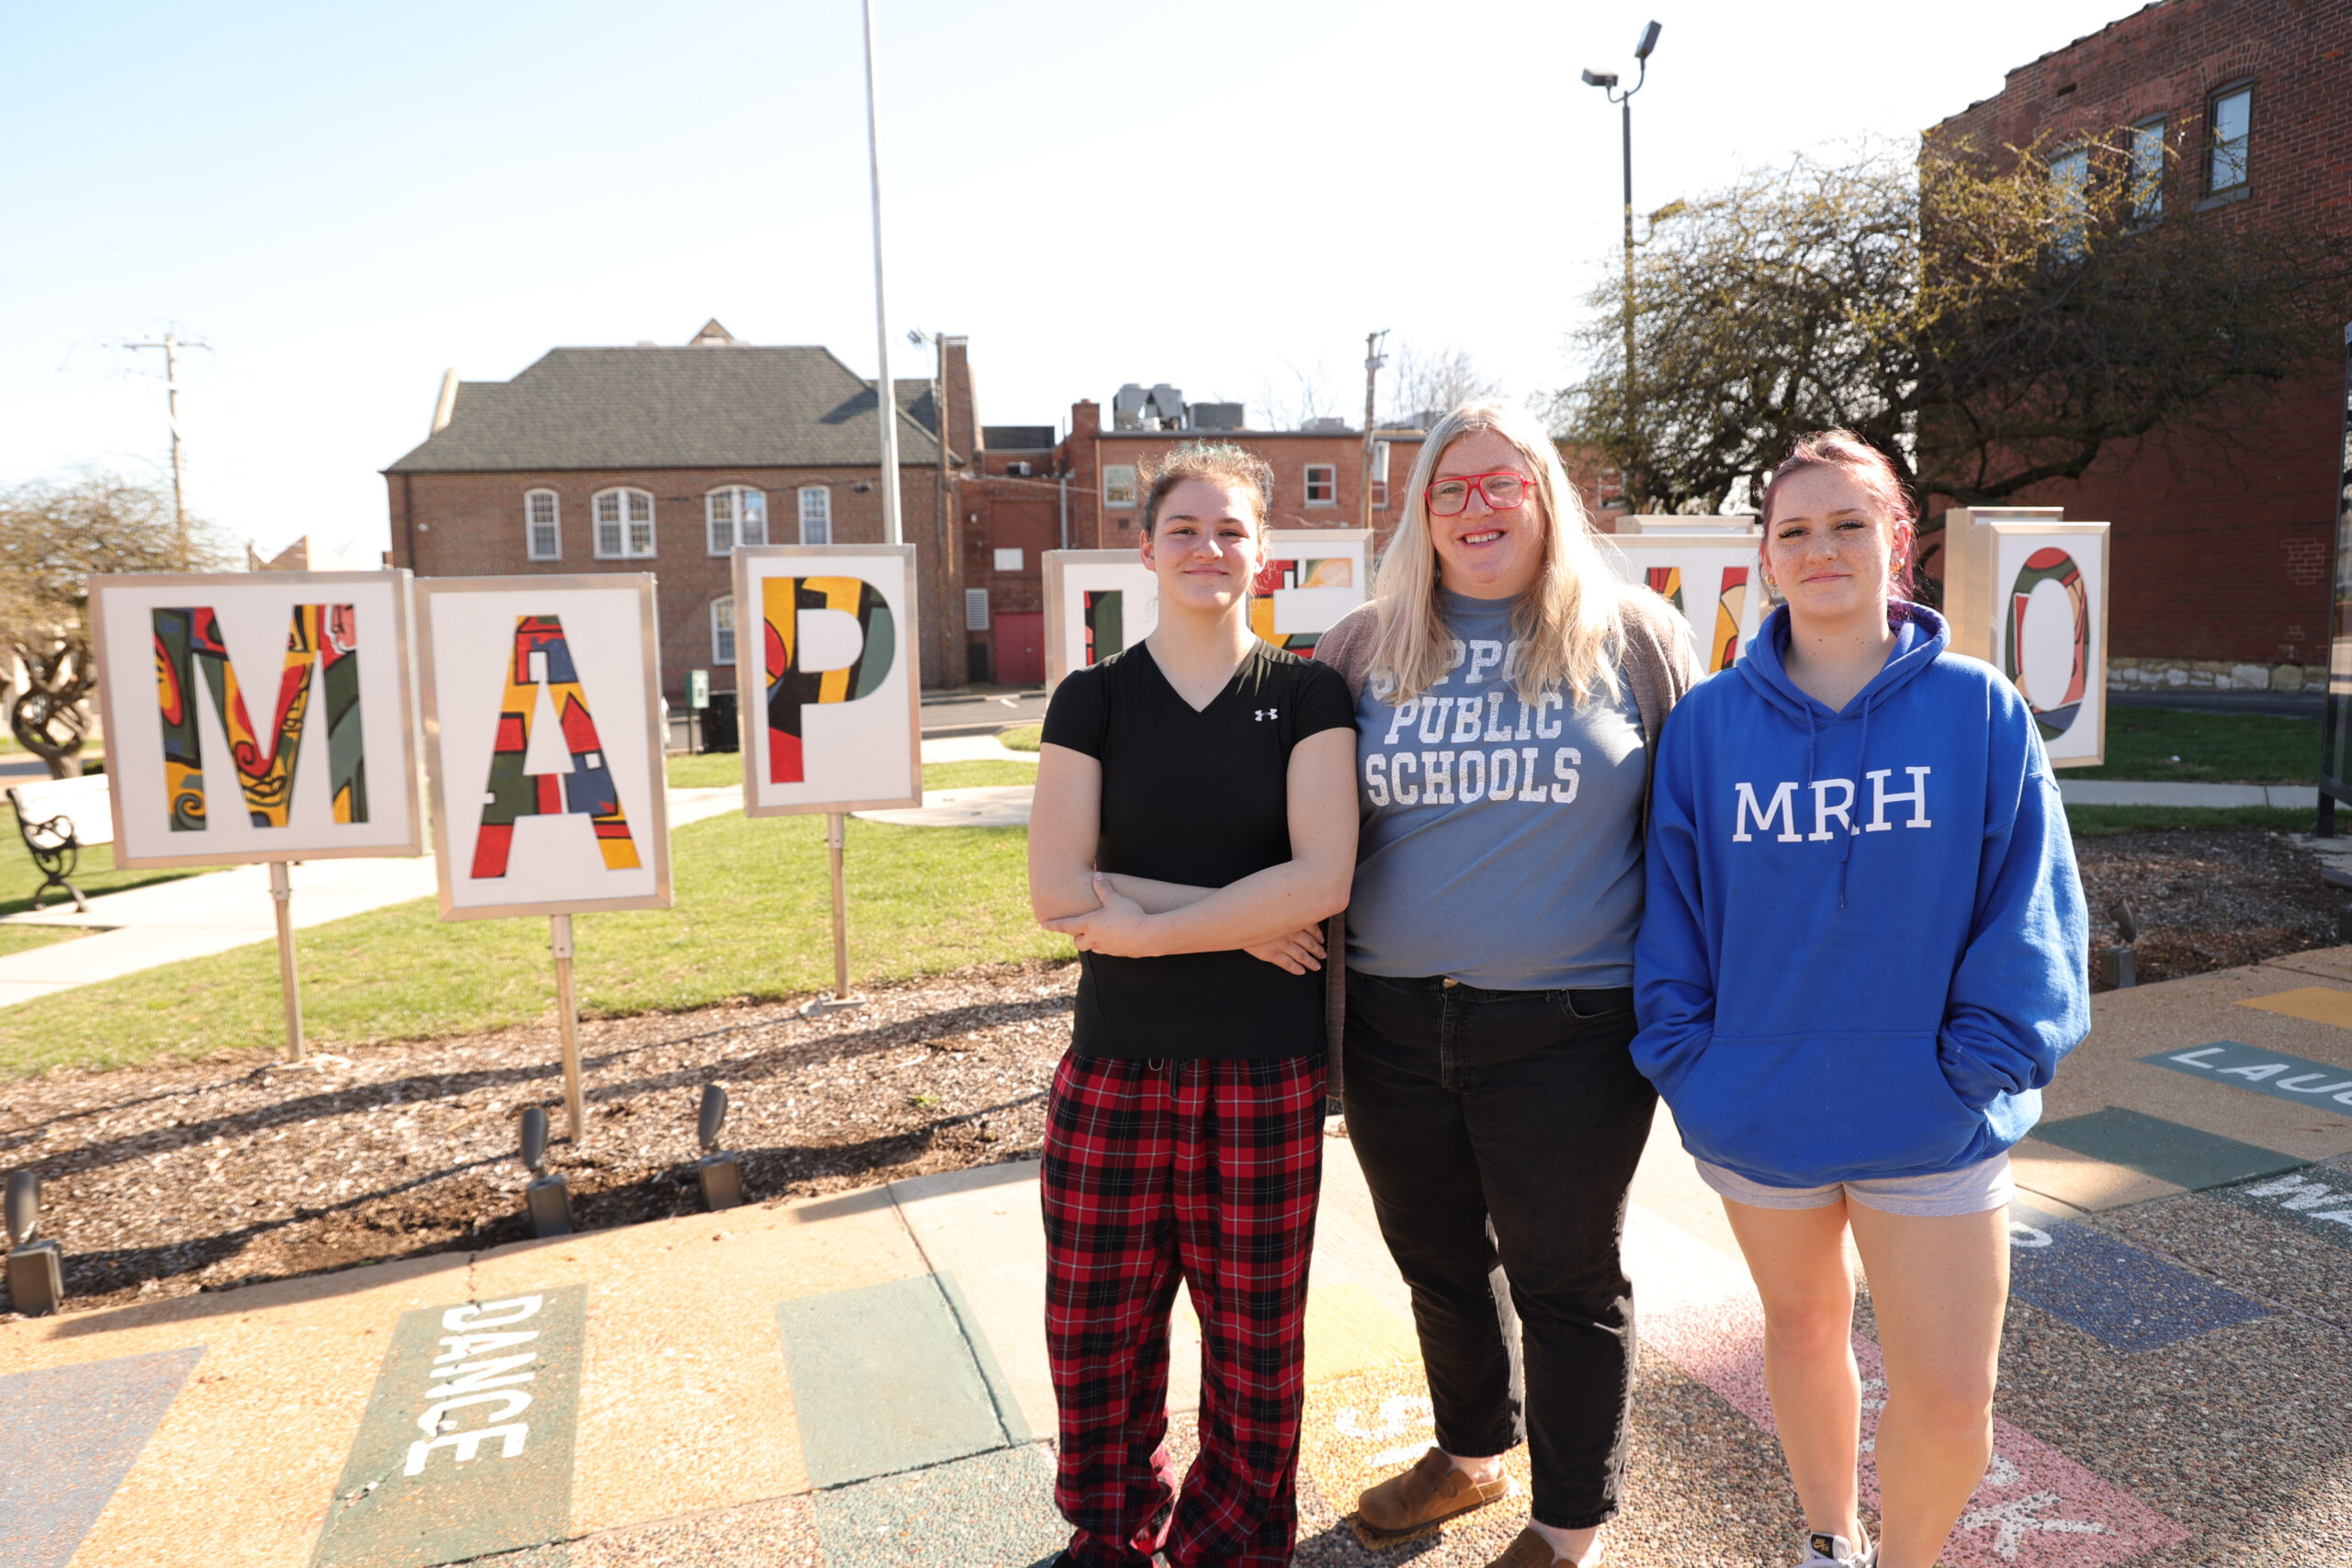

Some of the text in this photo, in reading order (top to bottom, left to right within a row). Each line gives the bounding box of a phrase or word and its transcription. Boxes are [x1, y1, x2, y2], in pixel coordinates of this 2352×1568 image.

[1384, 691, 1564, 745] PUBLIC
[1365, 747, 1582, 807] SCHOOLS
[1732, 766, 1932, 843] MRH
[403, 1293, 544, 1478] DANCE
